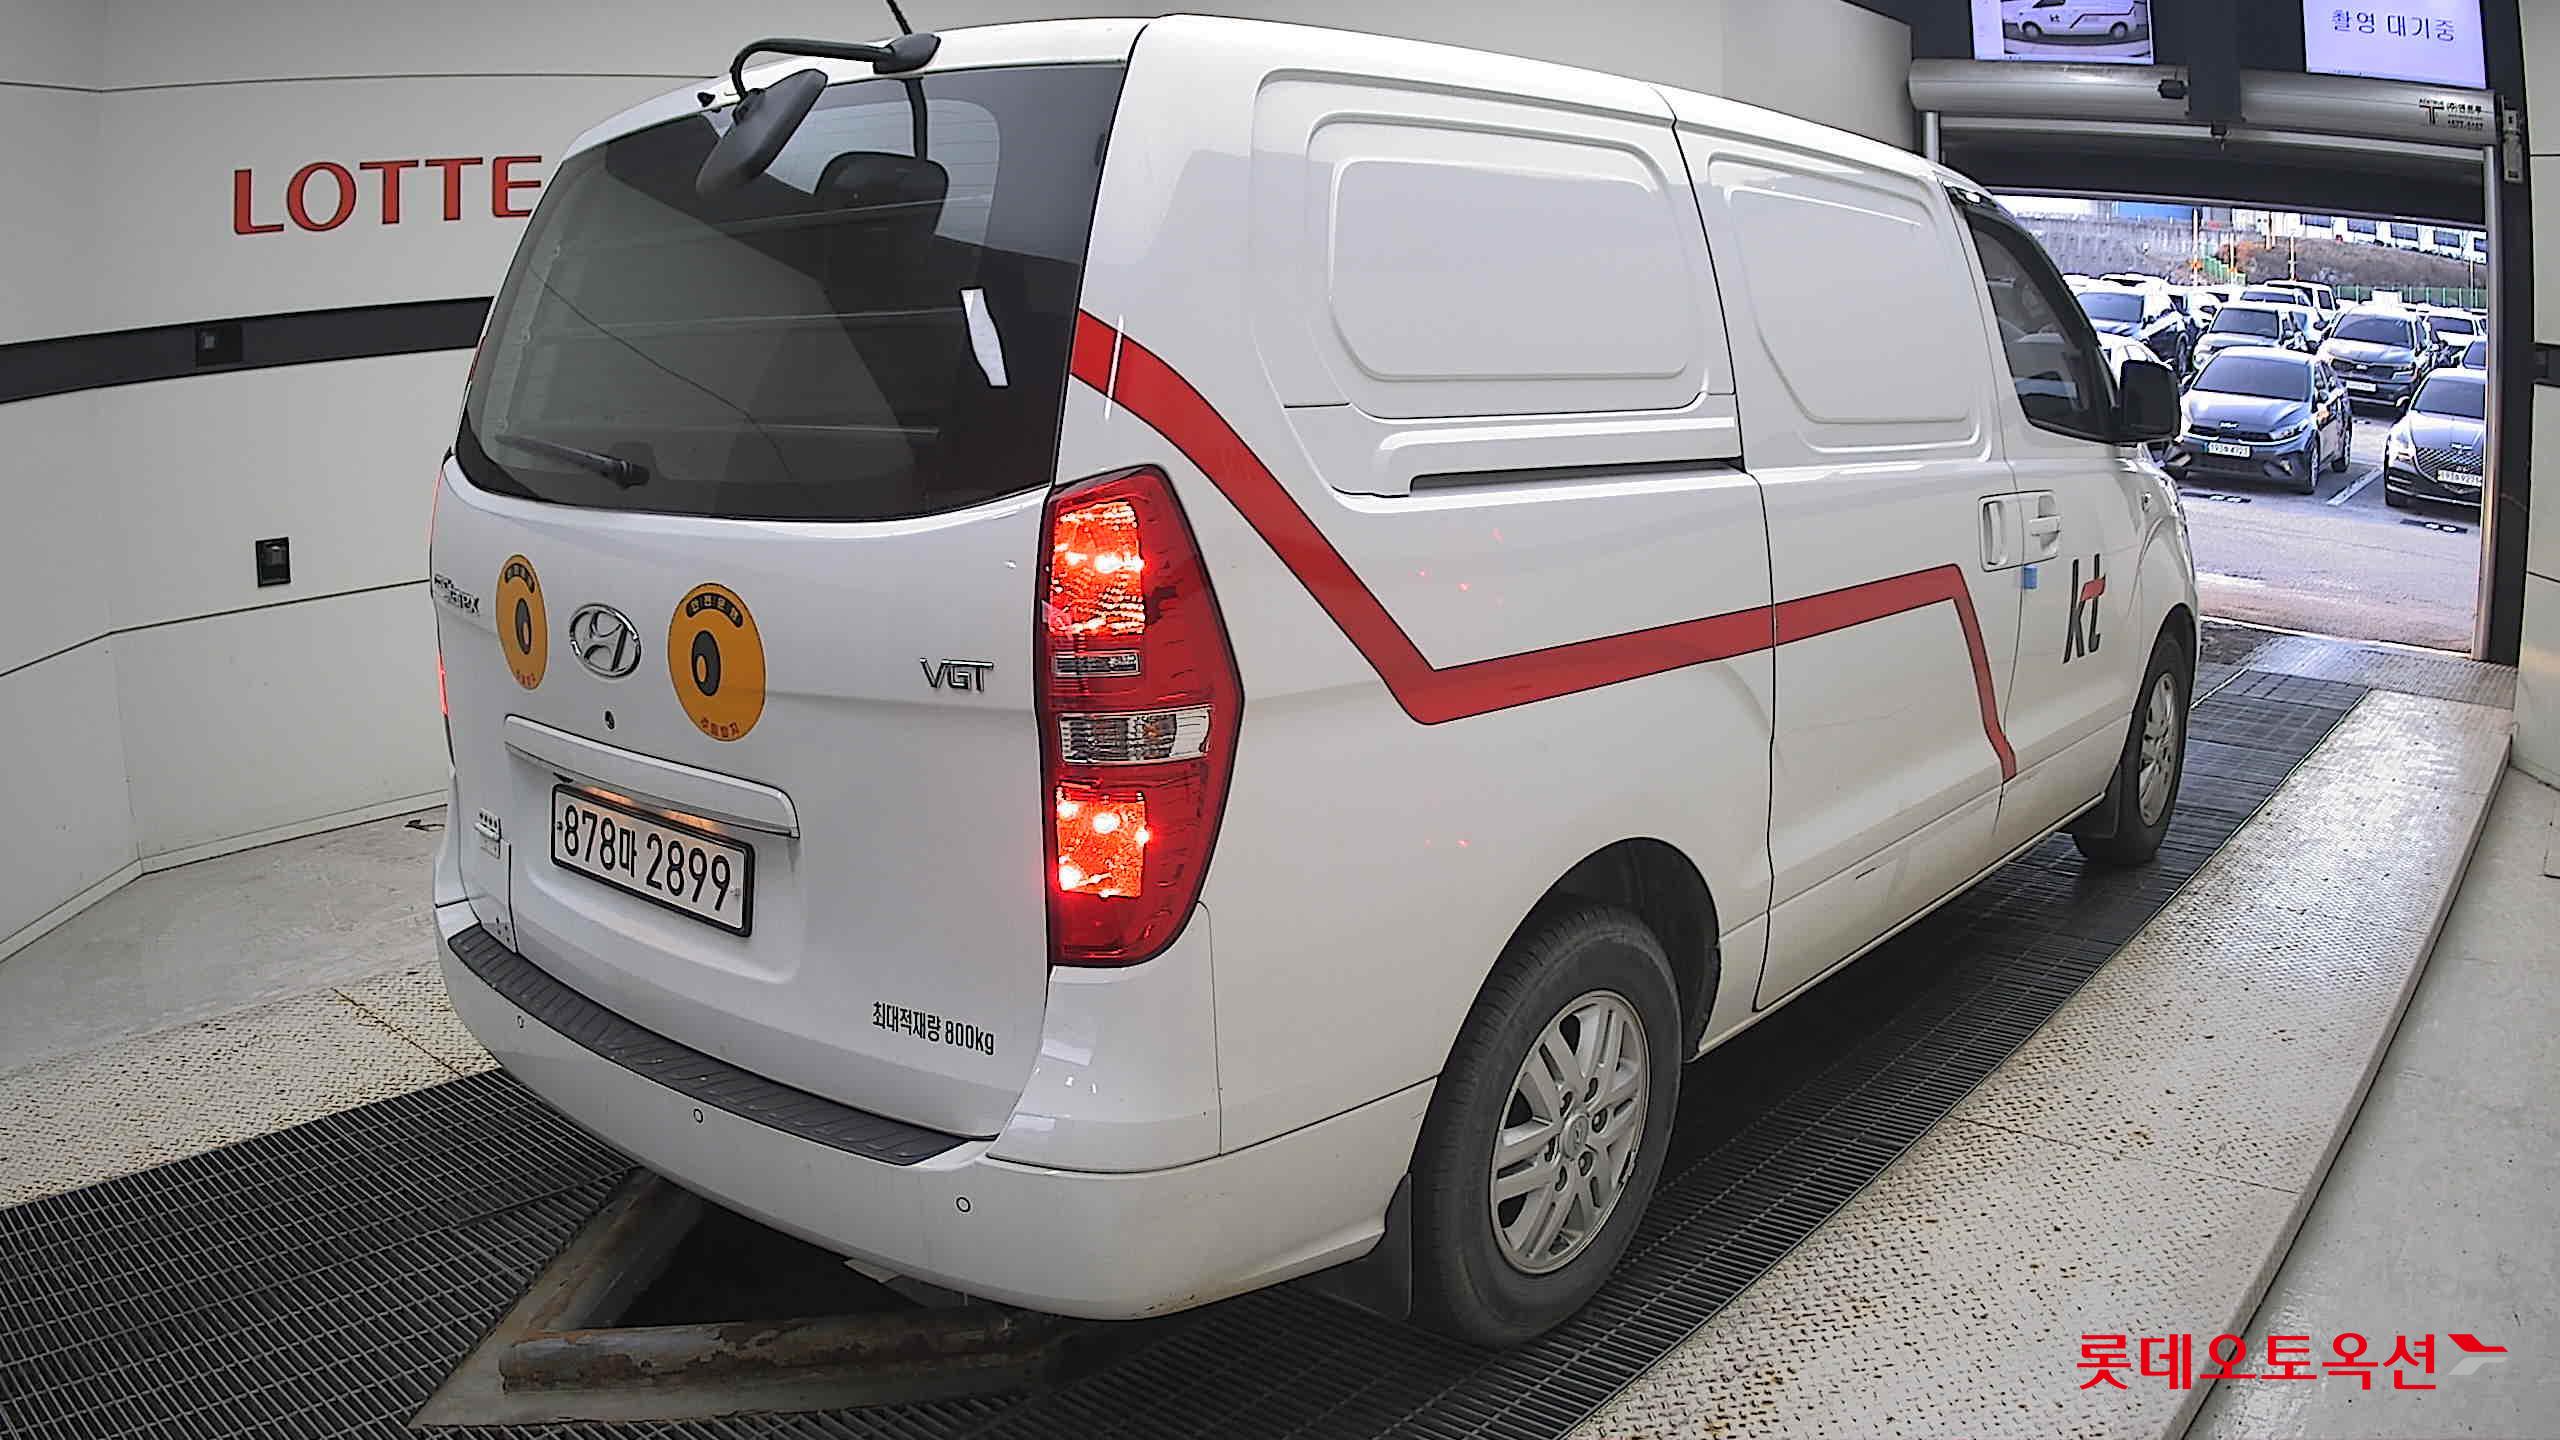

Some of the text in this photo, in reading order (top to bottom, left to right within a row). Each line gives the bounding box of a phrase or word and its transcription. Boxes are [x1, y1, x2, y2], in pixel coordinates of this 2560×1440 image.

[2332, 9, 2455, 42] 촬영 대기중
[234, 156, 542, 235] LOTTE
[2062, 553, 2106, 664] kt
[920, 657, 993, 692] VGT
[564, 804, 731, 911] 878마 2899
[872, 1001, 995, 1056] 최대적재량 800kg
